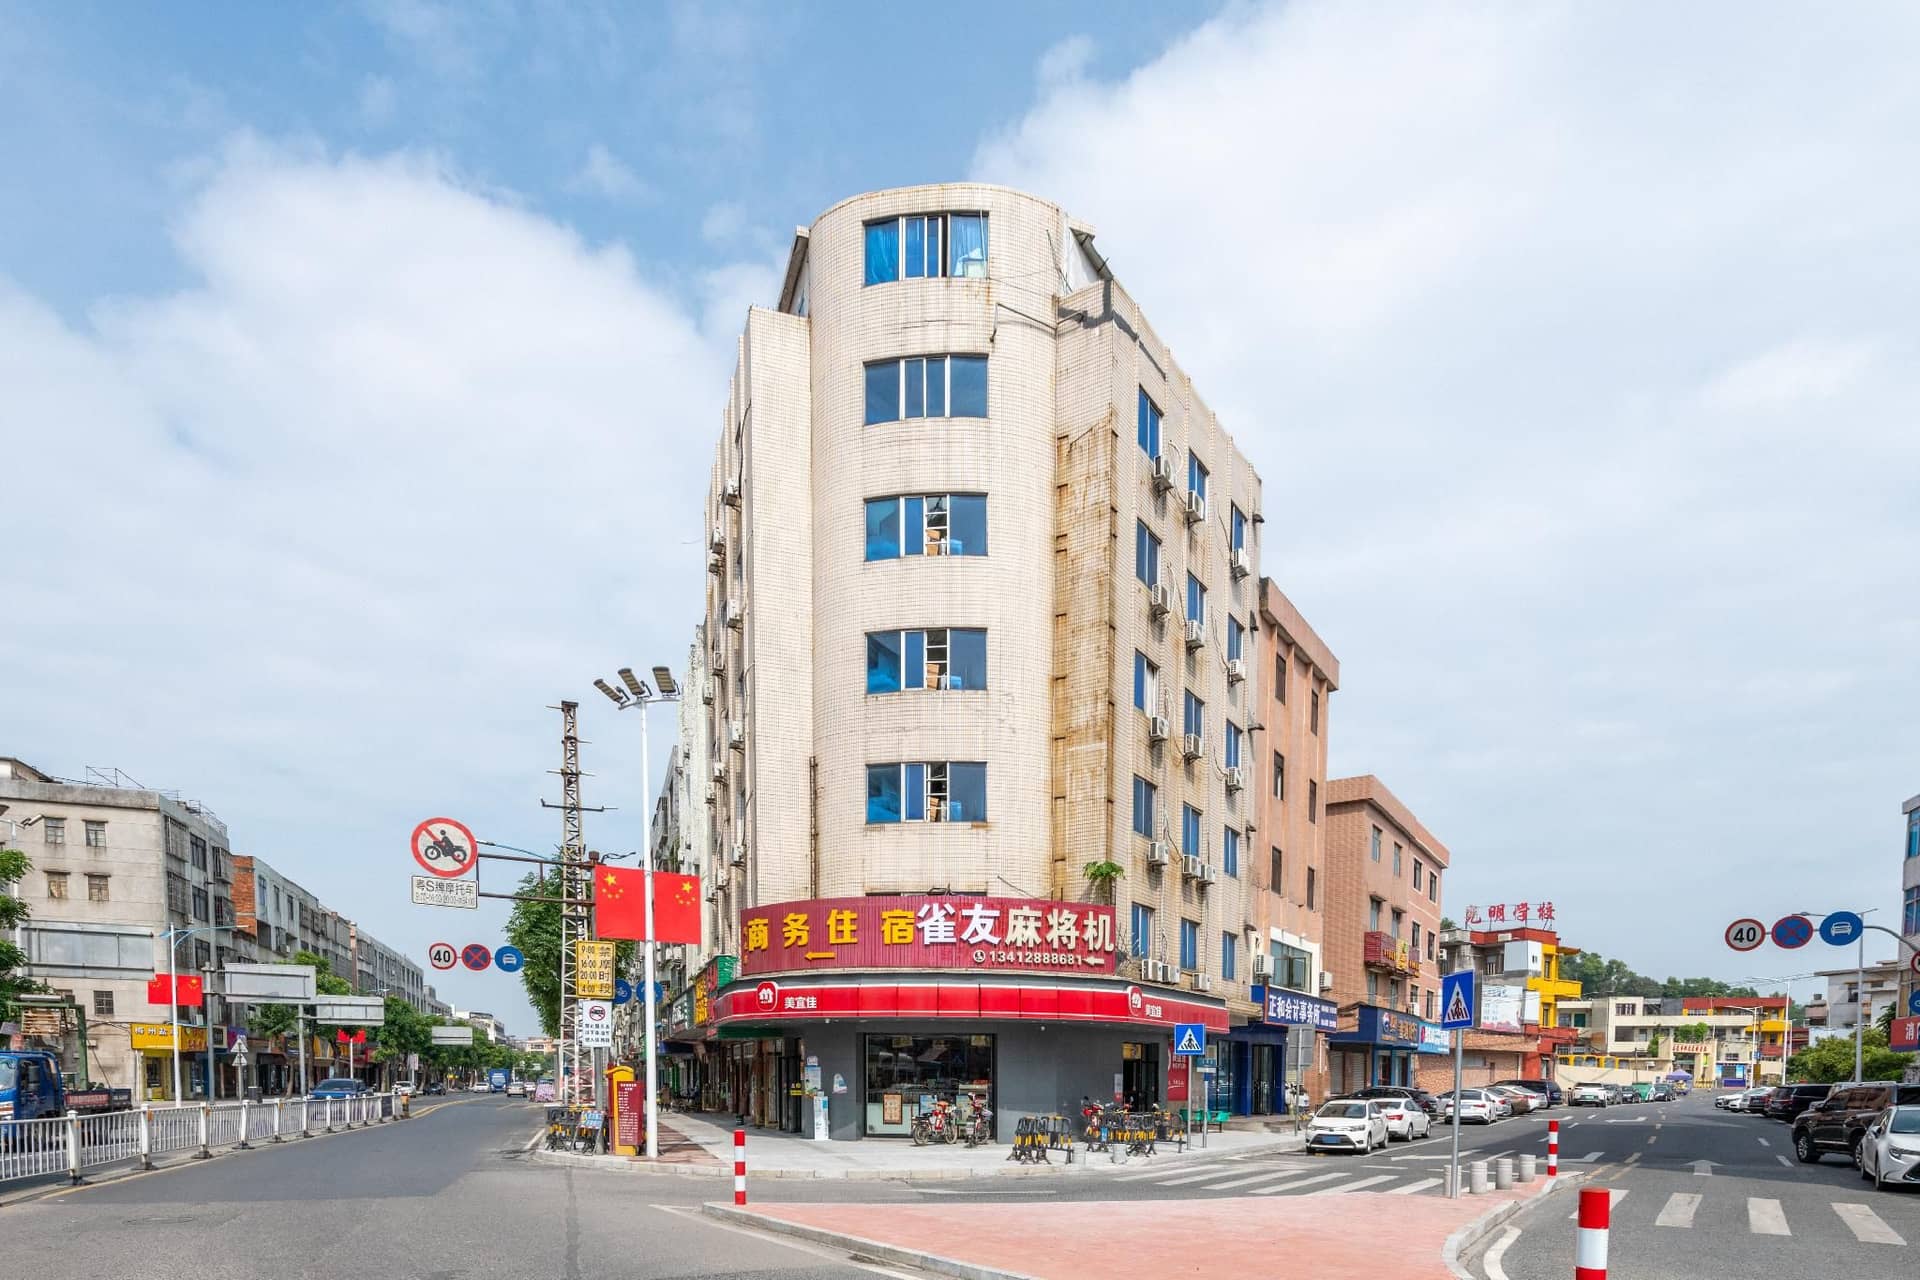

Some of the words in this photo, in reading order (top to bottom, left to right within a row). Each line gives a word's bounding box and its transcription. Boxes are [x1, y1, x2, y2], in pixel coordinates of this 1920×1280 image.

[747, 908, 916, 951] 商务住宿
[916, 903, 1114, 952] 雀友麻将机
[1733, 927, 1757, 943] 40
[433, 950, 451, 963] 40
[989, 951, 1082, 966] 13412888681
[784, 996, 817, 1009] 美宜佳
[1268, 994, 1320, 1025] 正和会计事务所
